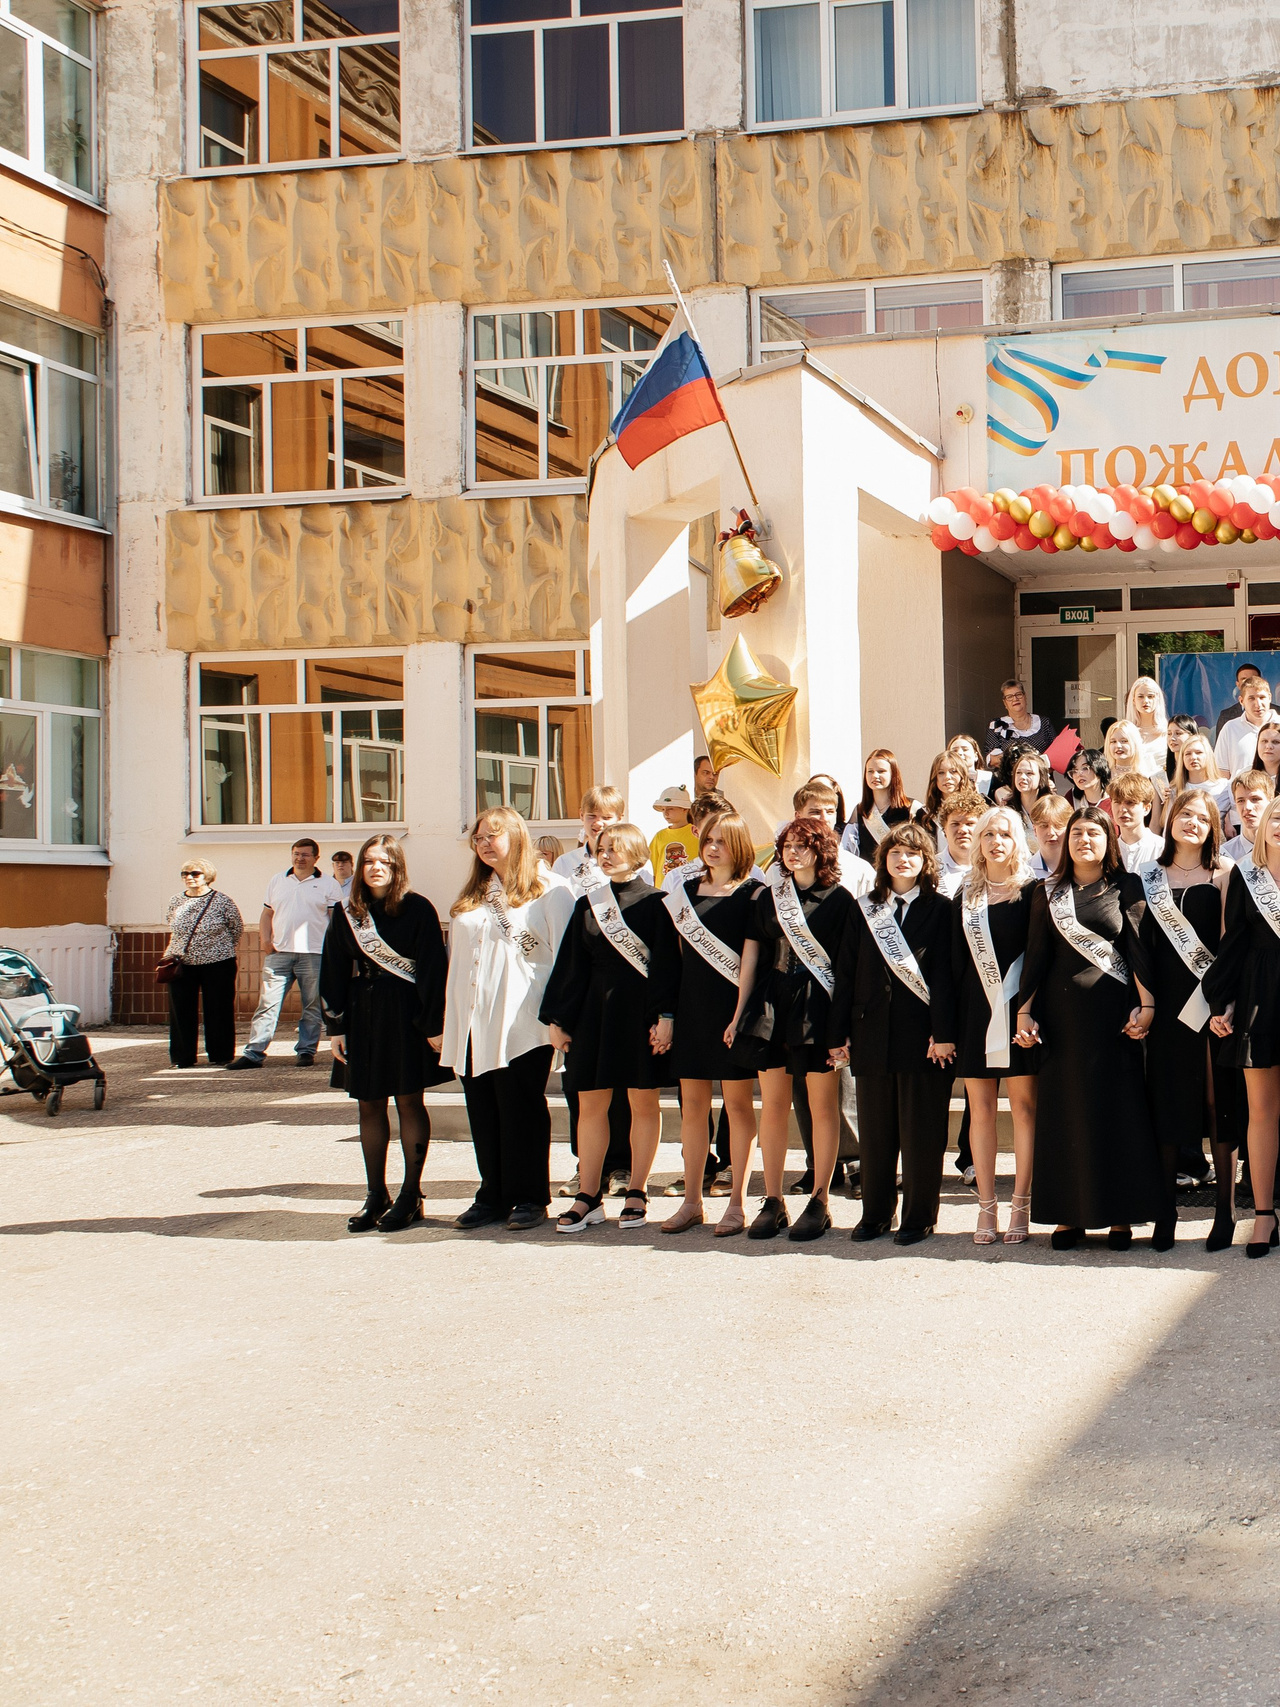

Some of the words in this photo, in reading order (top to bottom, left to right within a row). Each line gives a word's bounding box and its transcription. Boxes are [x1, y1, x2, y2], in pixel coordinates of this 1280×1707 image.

[1065, 610, 1090, 622] ВХОД
[512, 930, 540, 953] 2025
[778, 899, 820, 967] Выпускник
[1147, 884, 1191, 952] Выпускник
[1187, 946, 1214, 970] 2025
[682, 920, 741, 980] Выпускник
[981, 960, 1001, 985] 2025
